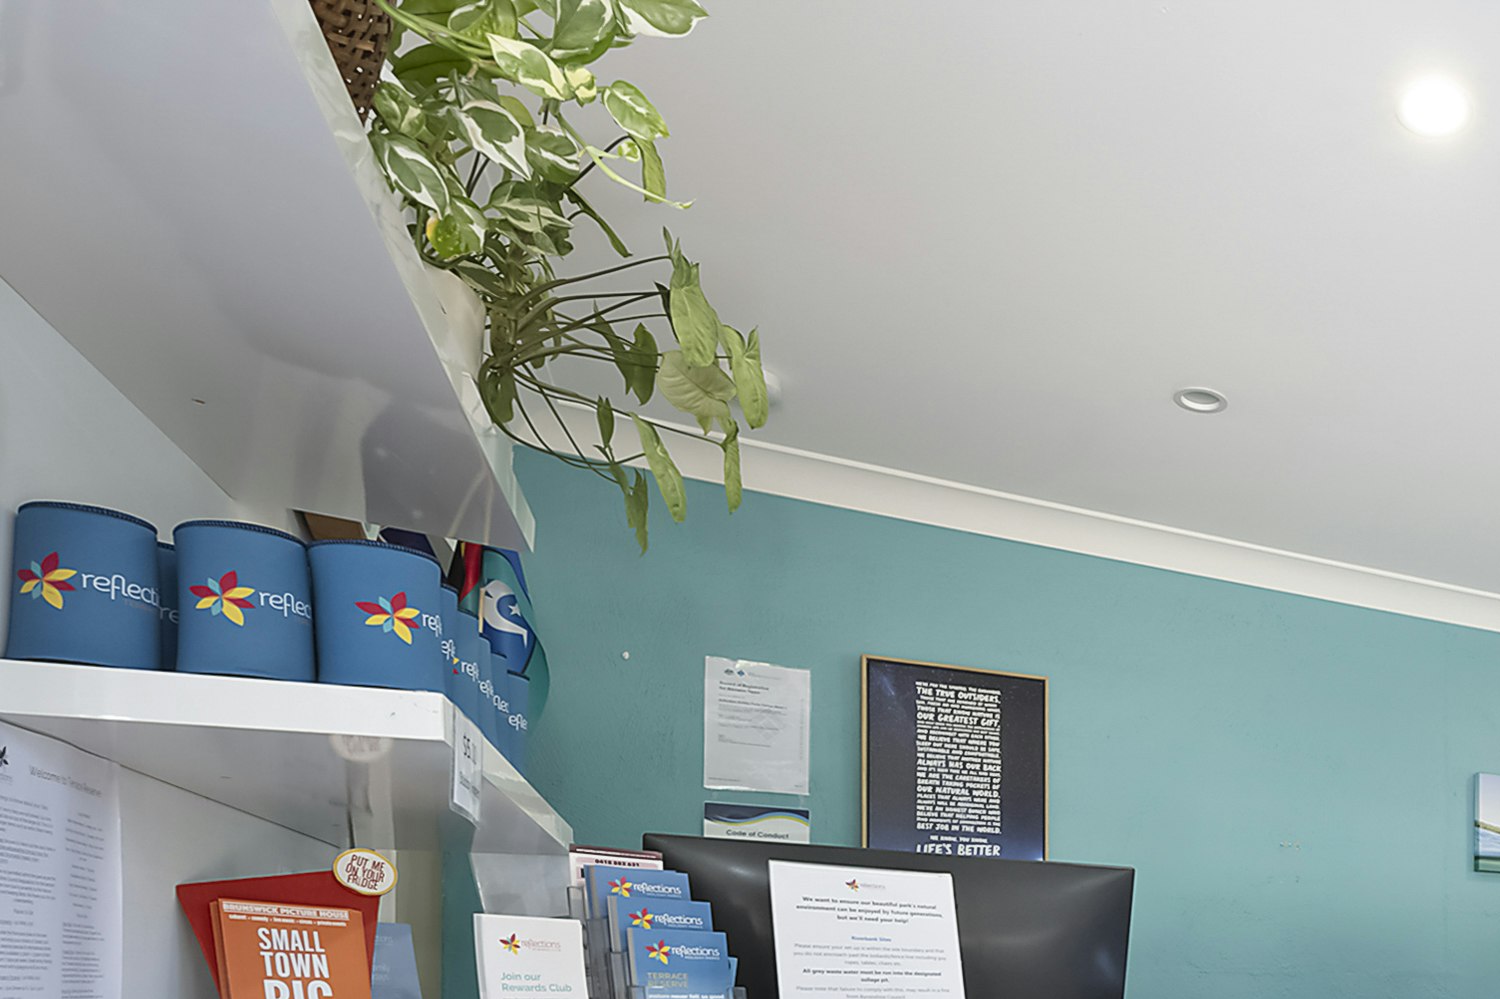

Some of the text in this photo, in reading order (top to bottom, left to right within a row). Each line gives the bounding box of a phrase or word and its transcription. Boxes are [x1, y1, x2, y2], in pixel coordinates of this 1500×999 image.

[916, 687, 933, 696] THE
[936, 689, 955, 698] TRUE
[917, 712, 935, 720] OUR
[937, 713, 979, 724] GREATEST
[917, 759, 946, 767] ALWAYS
[983, 764, 1001, 772] BACK
[935, 786, 970, 796] NATURAL
[916, 843, 1000, 856] LIFE'S BETTER
[351, 854, 385, 871] PUT ME
[345, 863, 385, 882] ON YOUR
[347, 874, 378, 890] FRIDGE
[634, 882, 682, 895] reflections
[872, 900, 898, 908] beautiful
[223, 902, 349, 920] BRUNSWICK PICTURE HOUSE
[655, 914, 703, 926] reflections
[257, 927, 325, 952] SMALL
[521, 939, 561, 949] reflections
[672, 945, 720, 957] reflections
[260, 951, 330, 978] TOWN
[501, 972, 522, 981] Join
[502, 983, 572, 992] Rewards Club
